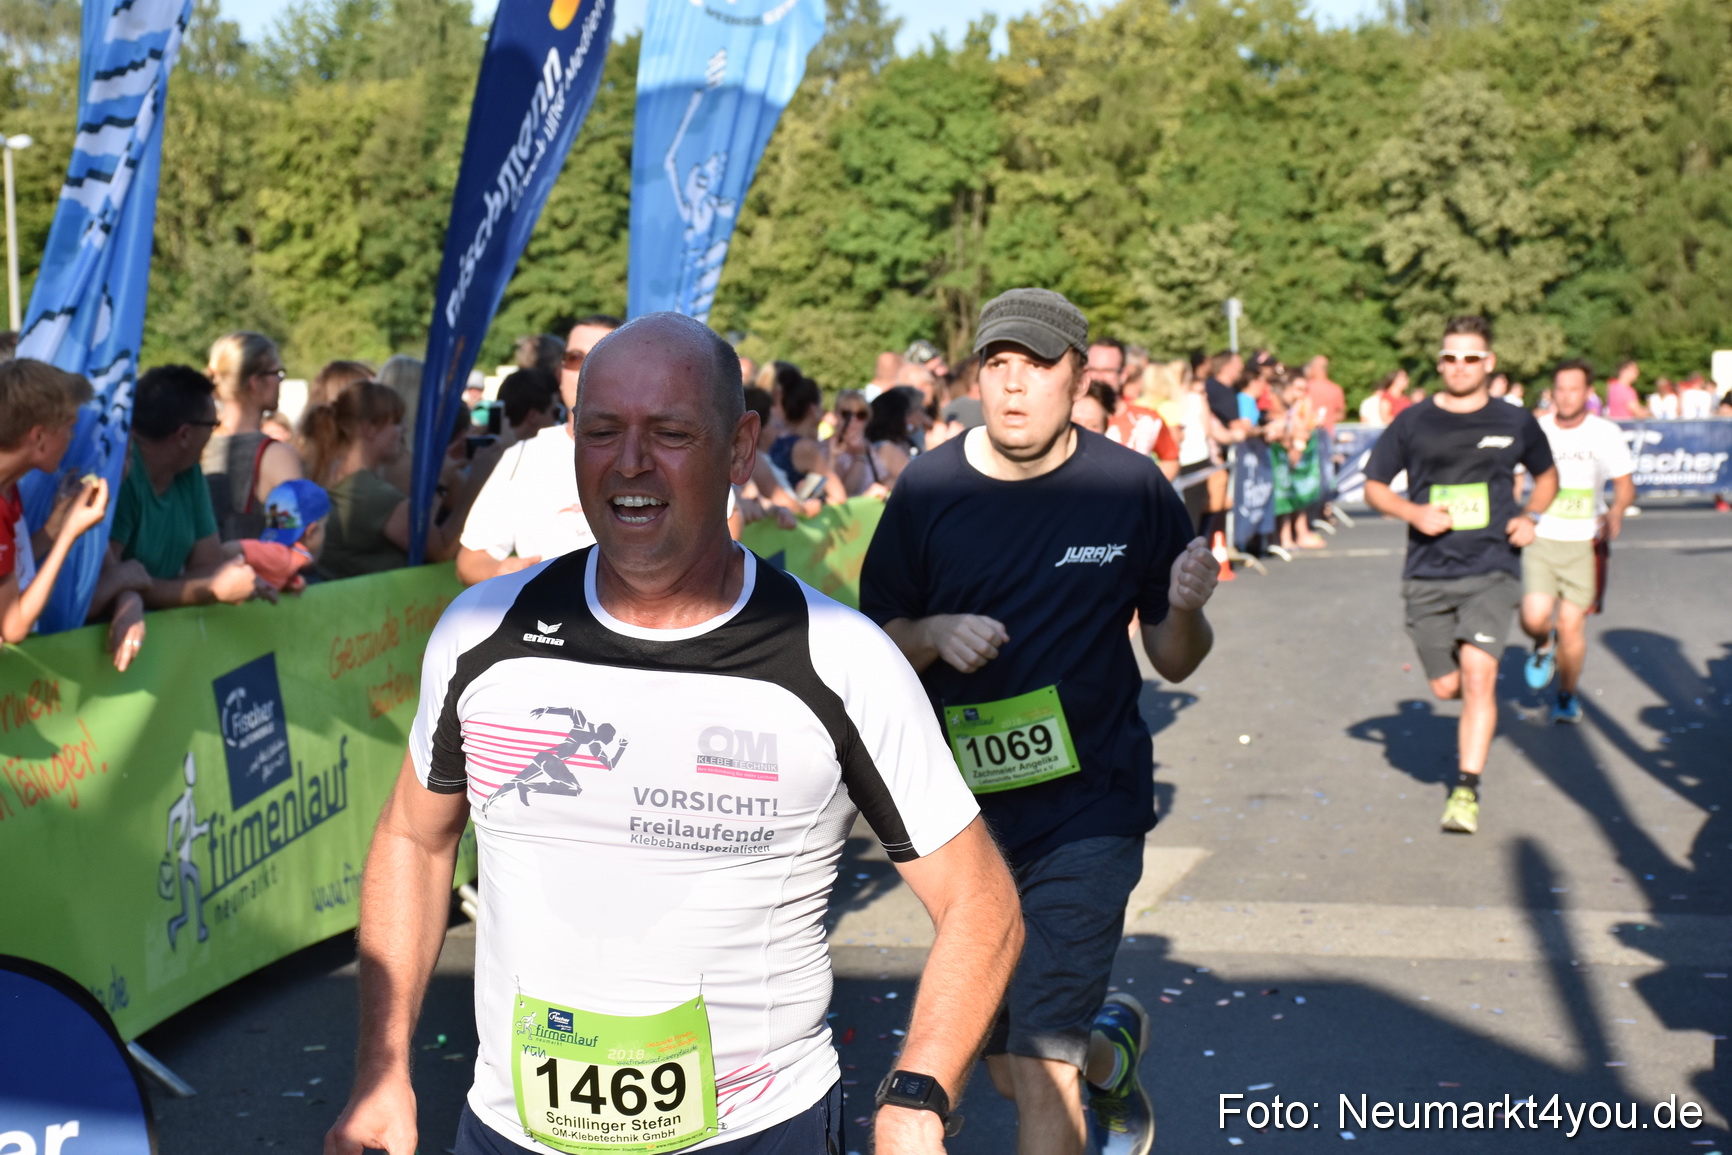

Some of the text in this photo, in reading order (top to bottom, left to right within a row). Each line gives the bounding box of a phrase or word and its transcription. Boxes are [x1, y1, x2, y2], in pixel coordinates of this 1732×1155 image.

[523, 632, 565, 646] erima
[231, 699, 275, 738] Fischer
[698, 726, 778, 763] OM
[966, 724, 1053, 768] 1069
[973, 755, 1059, 779] Zachmeier Angelika
[208, 735, 348, 891] firmenlauf
[633, 787, 779, 816] VORSICHT!
[630, 817, 775, 843] Freilaufende
[630, 834, 770, 855] Klebebandspezialisten
[535, 1024, 599, 1047] firmenlauf
[535, 1037, 562, 1046] neumarkt
[607, 1048, 645, 1060] 2018
[536, 1057, 686, 1116] 1469
[546, 1111, 681, 1134] Schillinger Stefan
[552, 1127, 639, 1143] OM-Klebetechnik
[643, 1128, 676, 1143] GmbH
